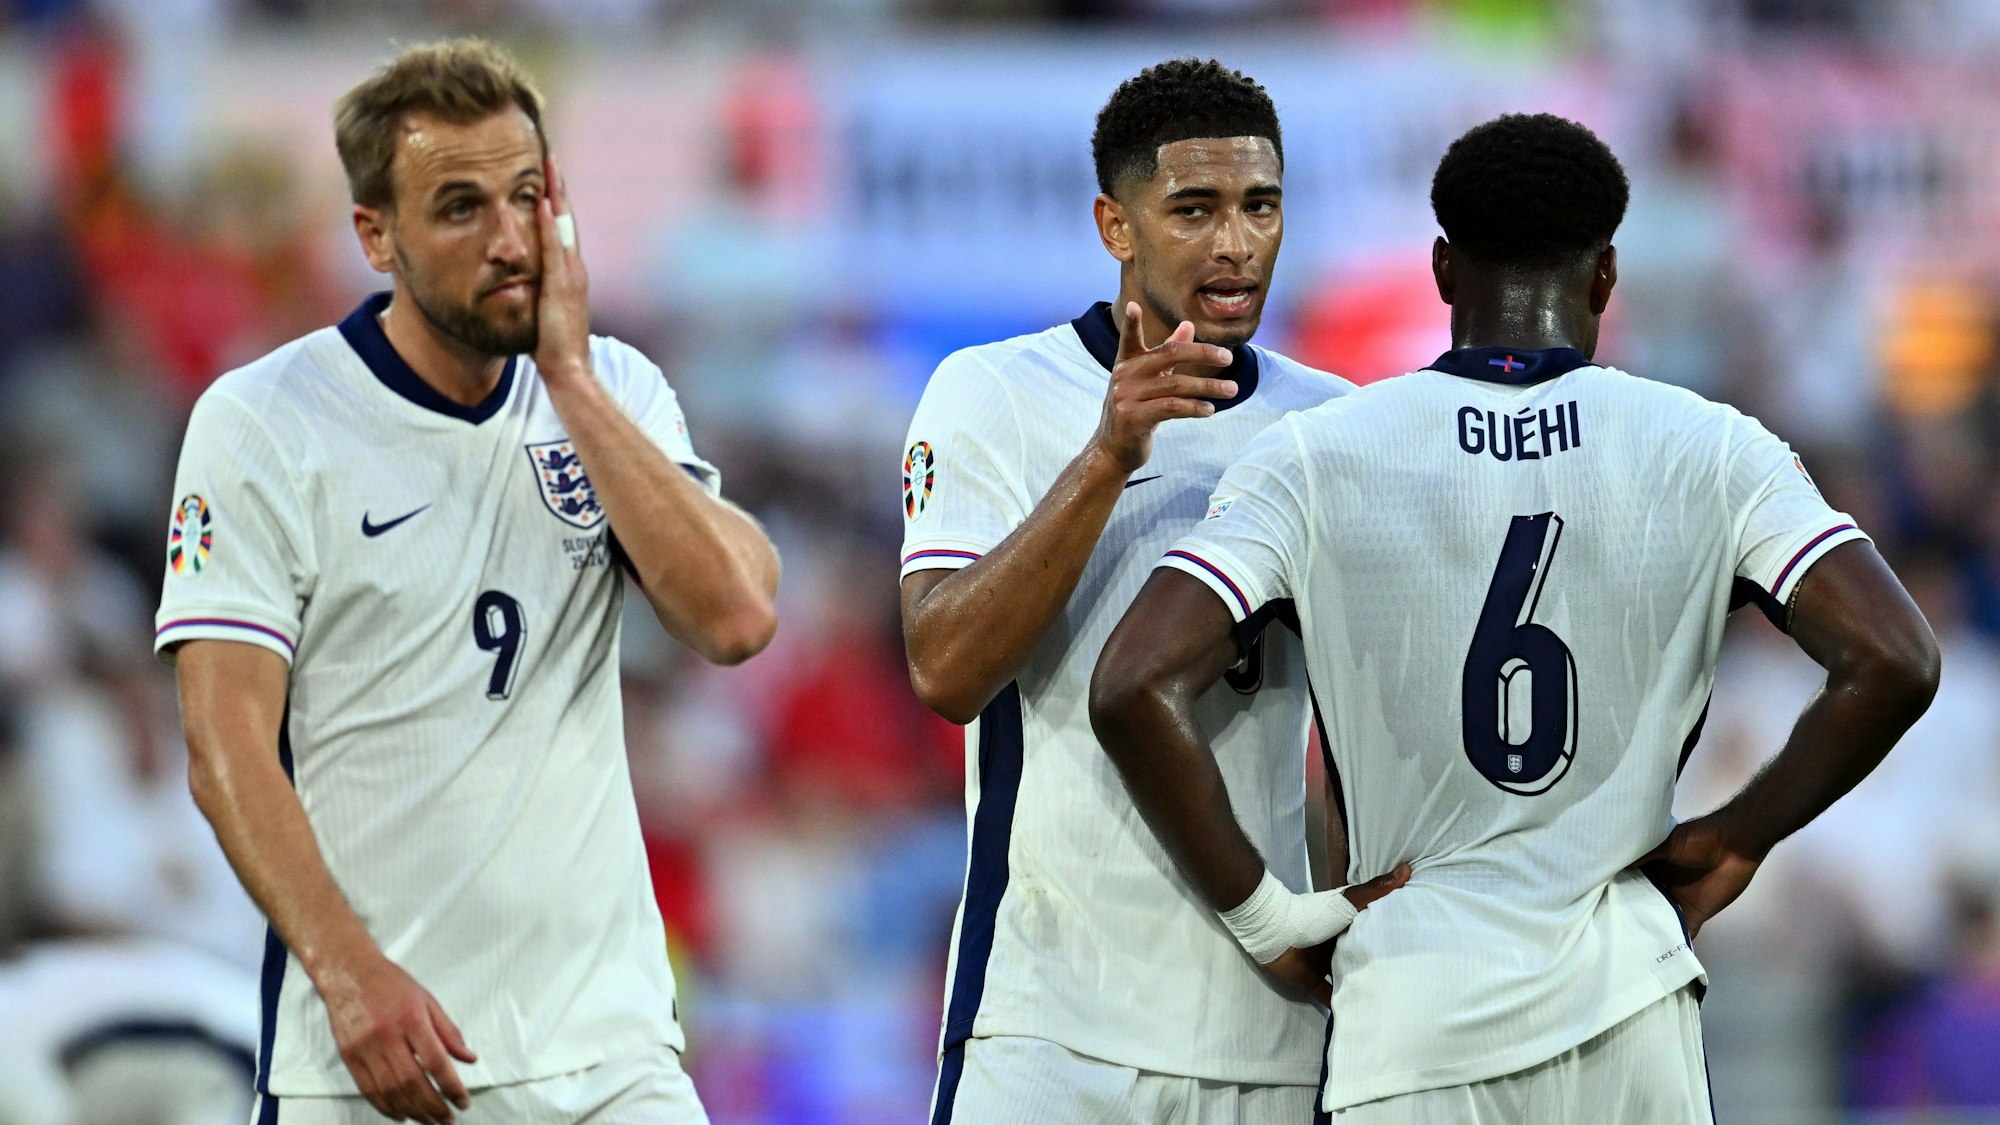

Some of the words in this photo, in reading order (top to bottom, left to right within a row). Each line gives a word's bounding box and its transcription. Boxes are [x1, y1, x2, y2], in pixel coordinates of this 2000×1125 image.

[1457, 400, 1581, 461] GUÉHI
[473, 590, 527, 701] 9
[1462, 511, 1579, 797] 6
